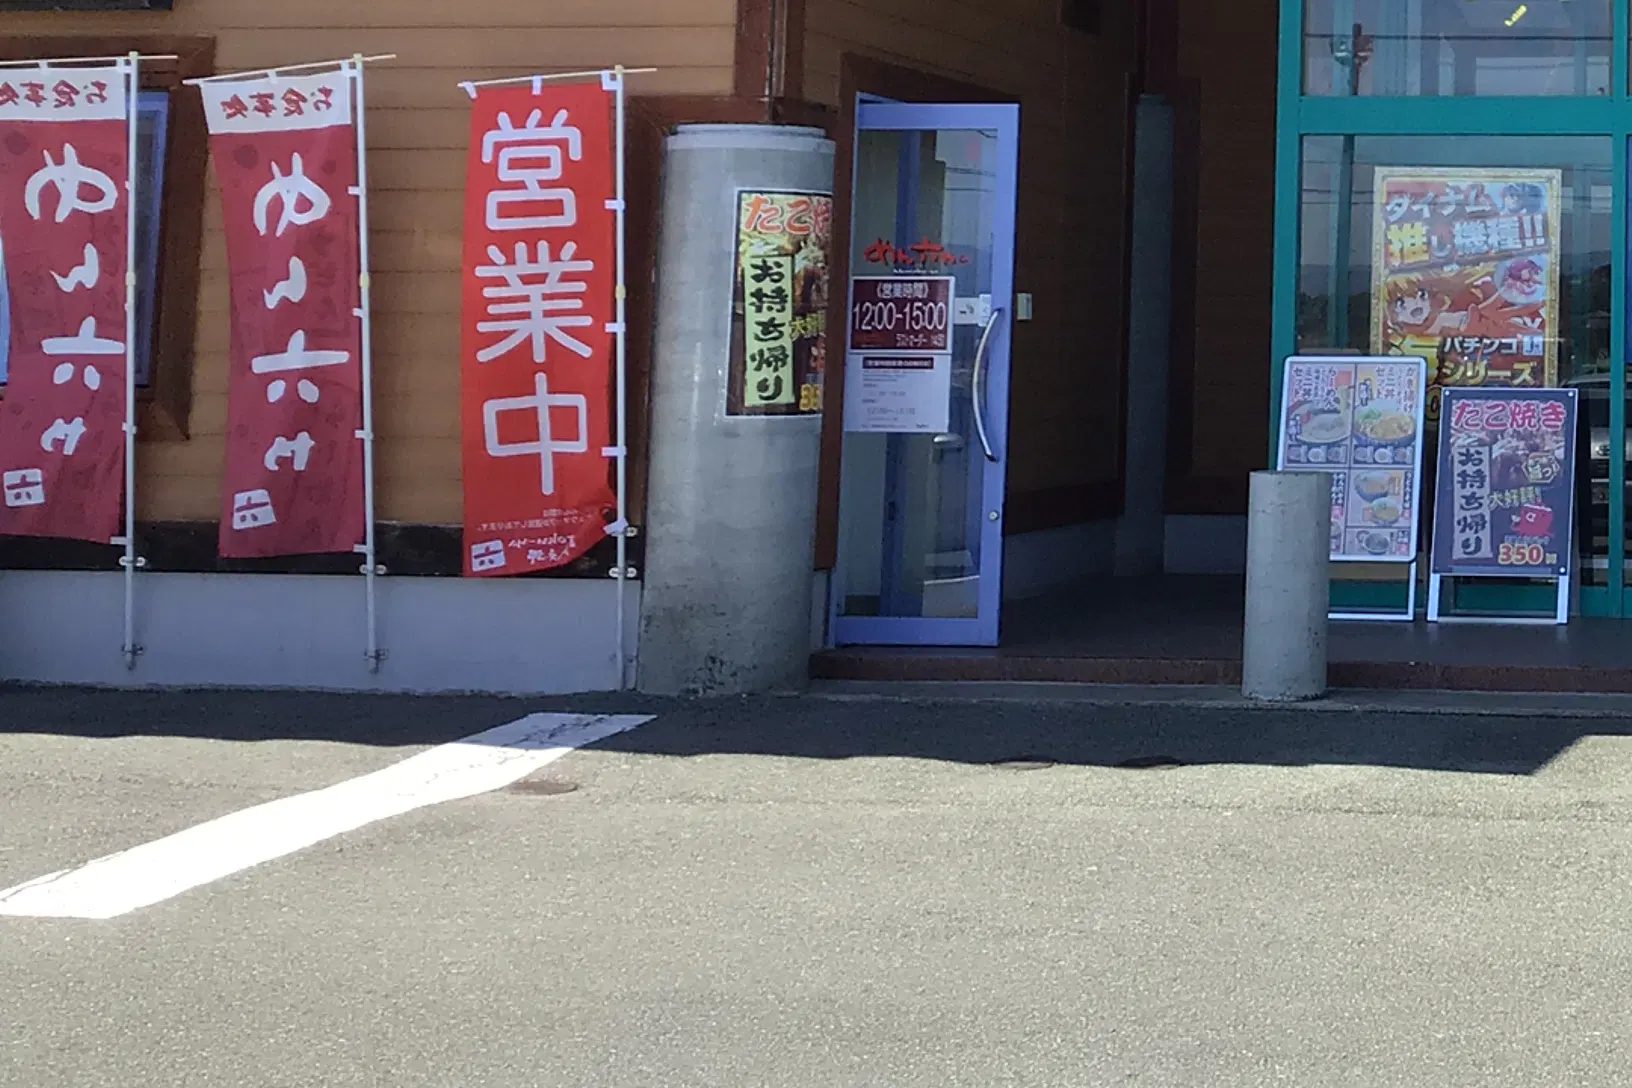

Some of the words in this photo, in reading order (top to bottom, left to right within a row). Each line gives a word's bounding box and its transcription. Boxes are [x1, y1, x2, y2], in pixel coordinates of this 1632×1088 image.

[1386, 183, 1492, 222] ダイナム
[749, 257, 790, 402] お持ち帰り
[1444, 337, 1518, 354] パチンコ
[1442, 360, 1538, 385] シリーズ
[1453, 400, 1566, 431] たこ焼き
[1457, 448, 1487, 556] お持ち帰り
